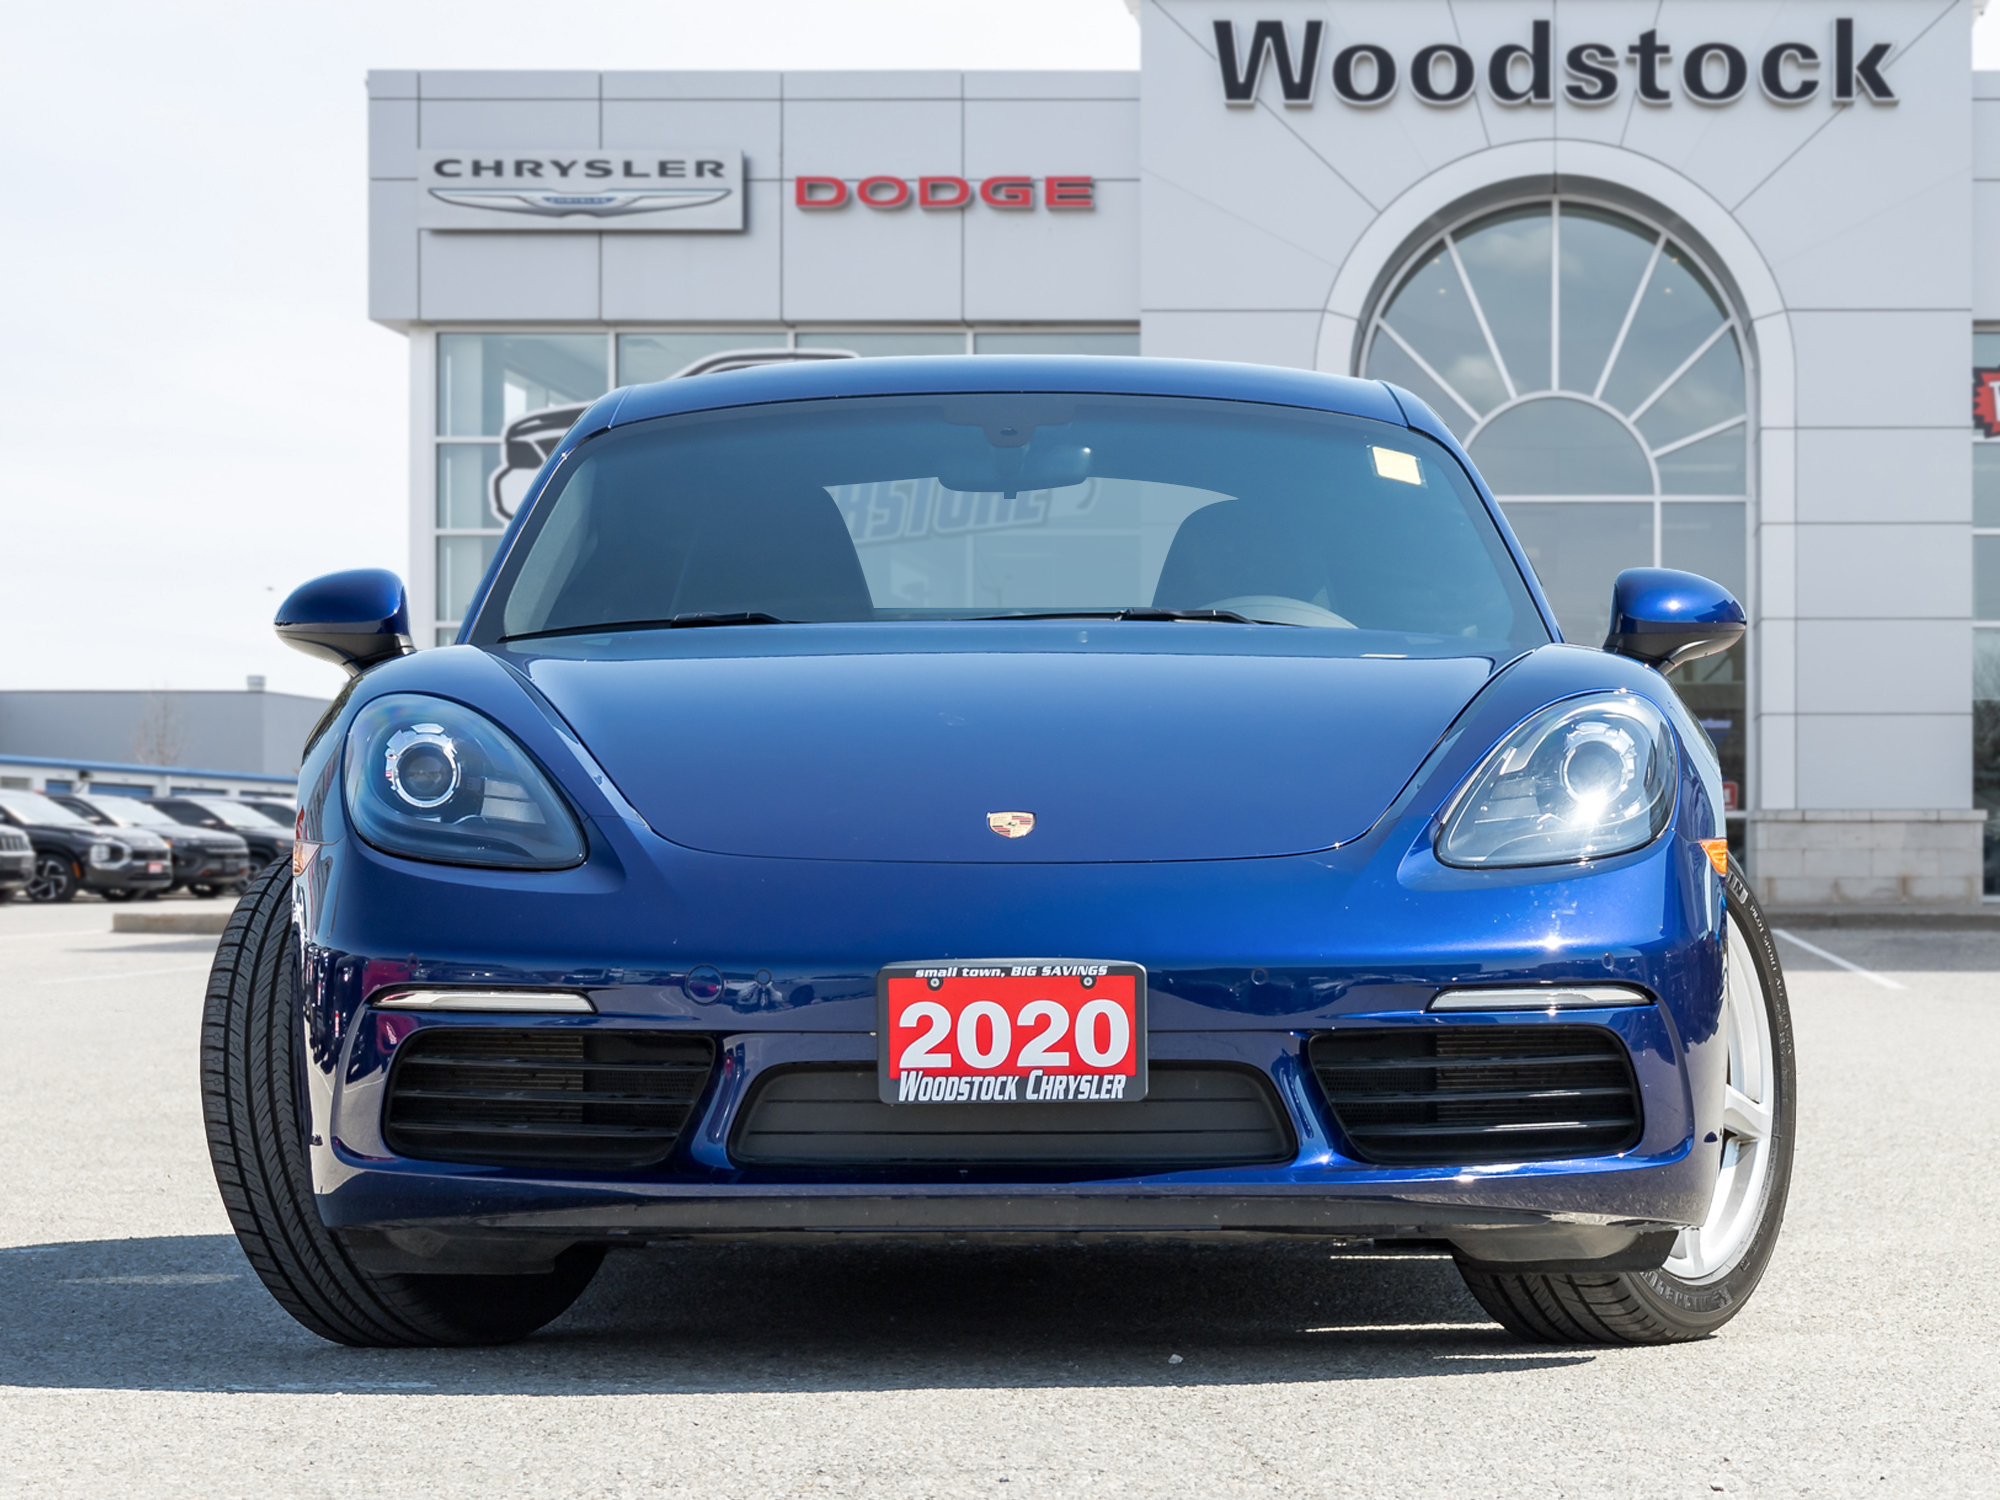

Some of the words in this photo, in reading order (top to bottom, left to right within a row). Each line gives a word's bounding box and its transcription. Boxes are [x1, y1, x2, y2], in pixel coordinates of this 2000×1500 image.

[1212, 17, 1898, 106] Woodstock
[433, 158, 726, 179] CHRYSLER
[794, 175, 1095, 210] DODGE
[914, 966, 958, 978] small
[961, 967, 1005, 979] town,
[1010, 966, 1037, 977] BIG
[1041, 965, 1109, 977] SAVINGS
[898, 999, 1130, 1069] 2020
[898, 1069, 1020, 1102] WOODSTOCK
[1025, 1068, 1127, 1101] CHRYSLER
